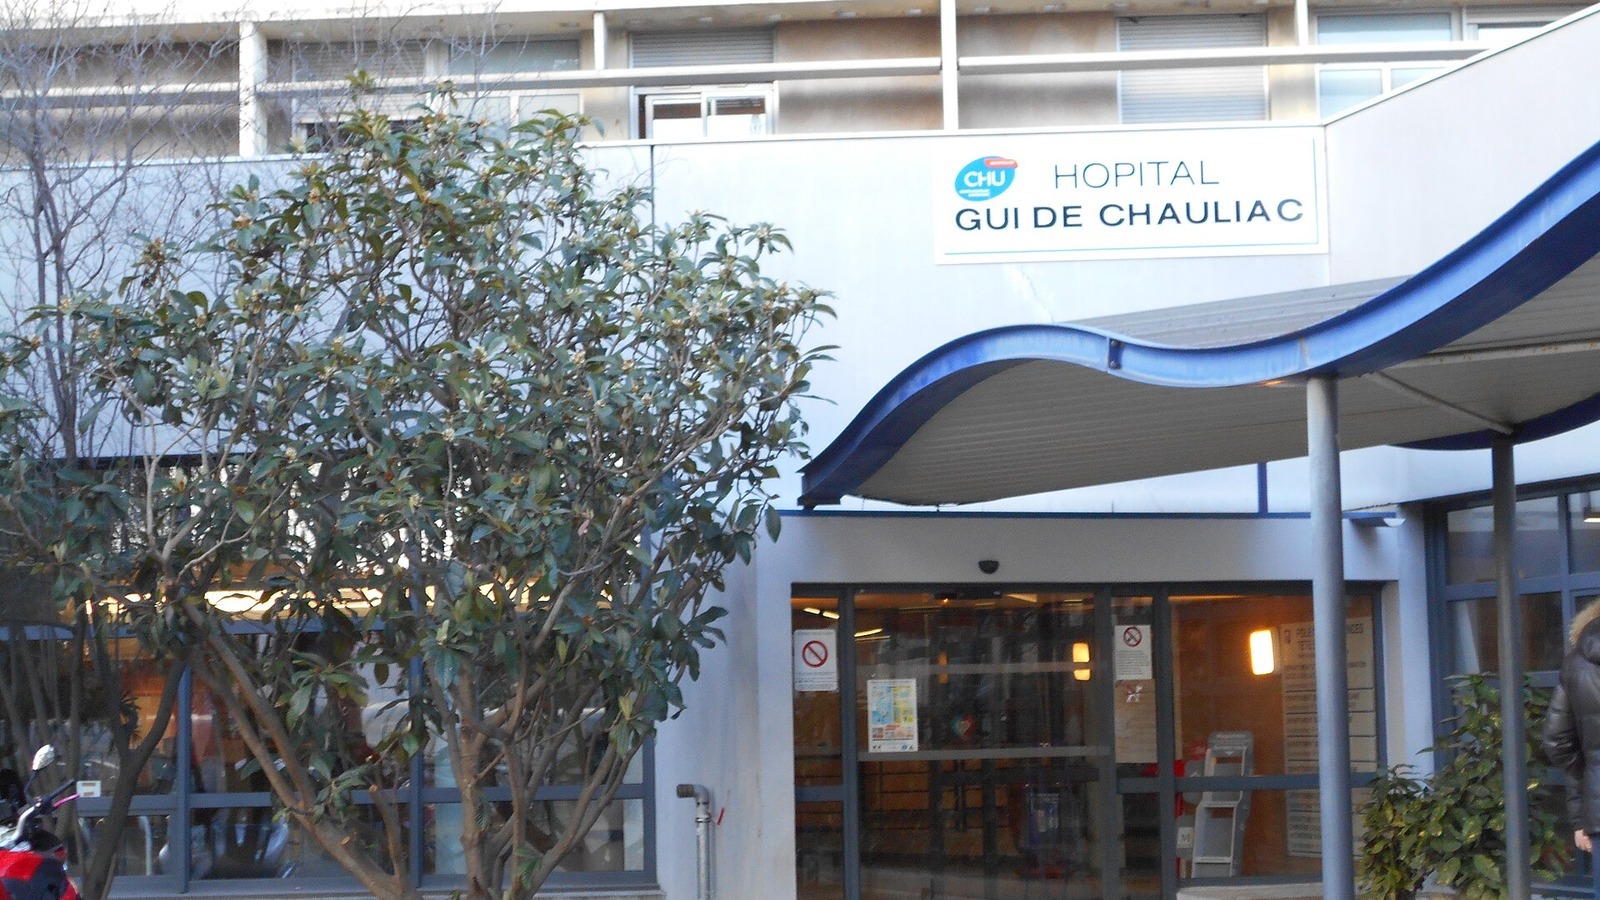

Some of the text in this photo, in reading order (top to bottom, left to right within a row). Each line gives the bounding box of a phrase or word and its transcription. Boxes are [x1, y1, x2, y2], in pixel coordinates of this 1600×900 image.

[963, 170, 1006, 188] CHU
[1054, 161, 1220, 189] HOPITAL
[955, 199, 1303, 231] GUI DE CHAULIAC
